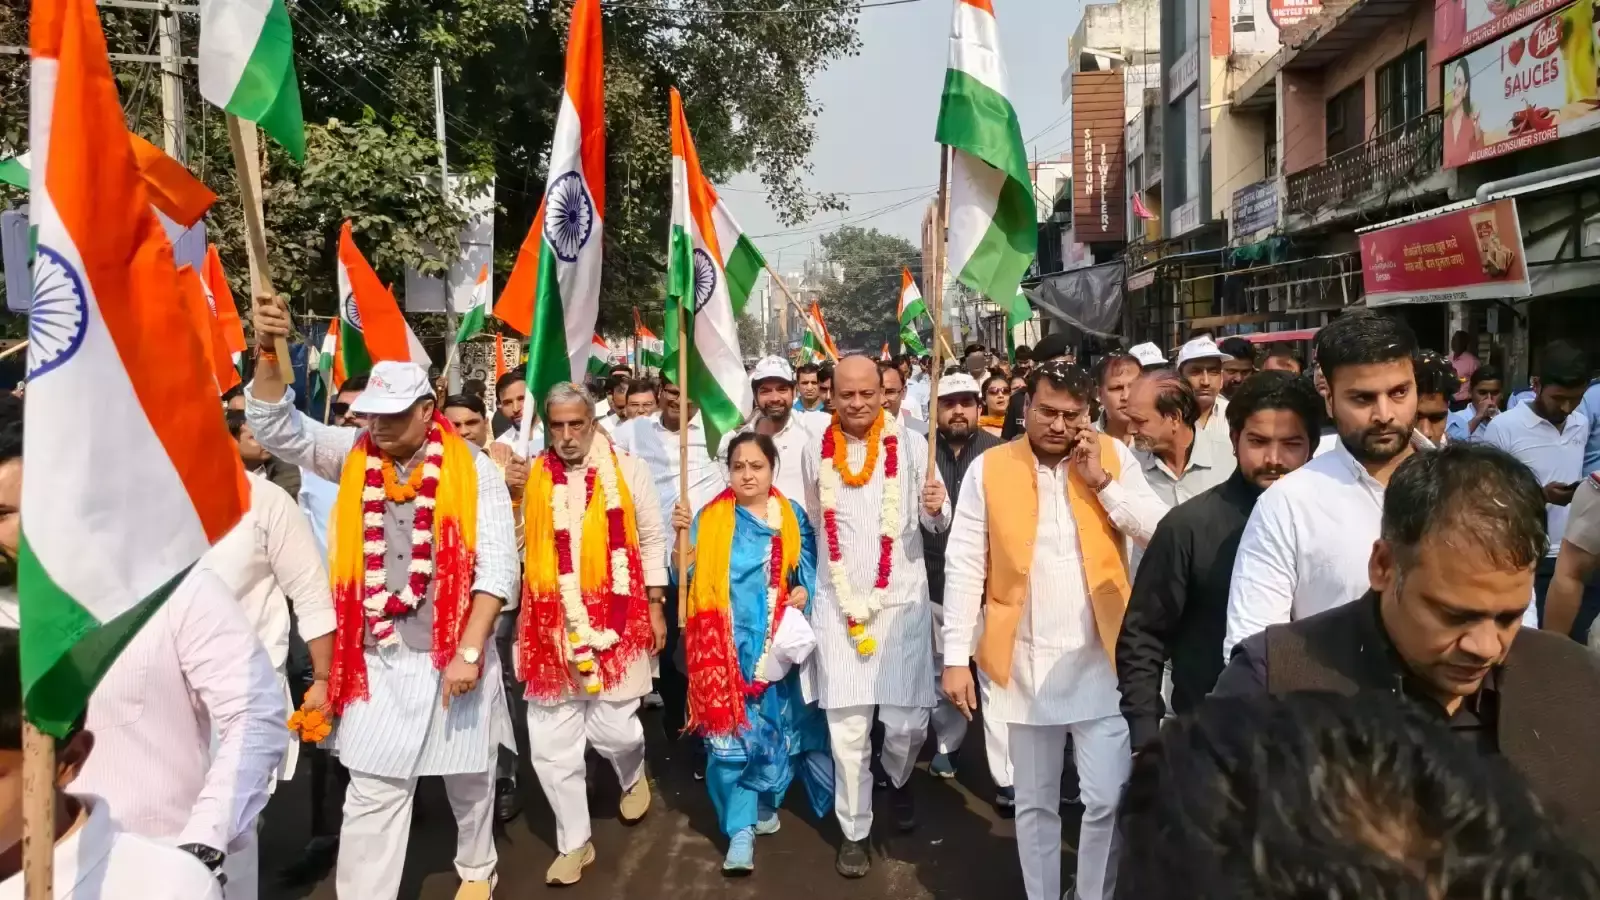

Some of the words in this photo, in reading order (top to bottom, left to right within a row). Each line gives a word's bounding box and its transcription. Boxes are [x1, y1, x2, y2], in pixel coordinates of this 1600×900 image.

[1502, 0, 1545, 27] CONSUMER
[1535, 20, 1559, 50] Tops
[1504, 57, 1559, 99] SAUCES
[1083, 128, 1093, 196] SHAGUN
[1467, 150, 1476, 162] JAI
[1476, 147, 1497, 160] DURGA
[1497, 135, 1532, 154] CONSUMER
[1533, 128, 1557, 144] STORE
